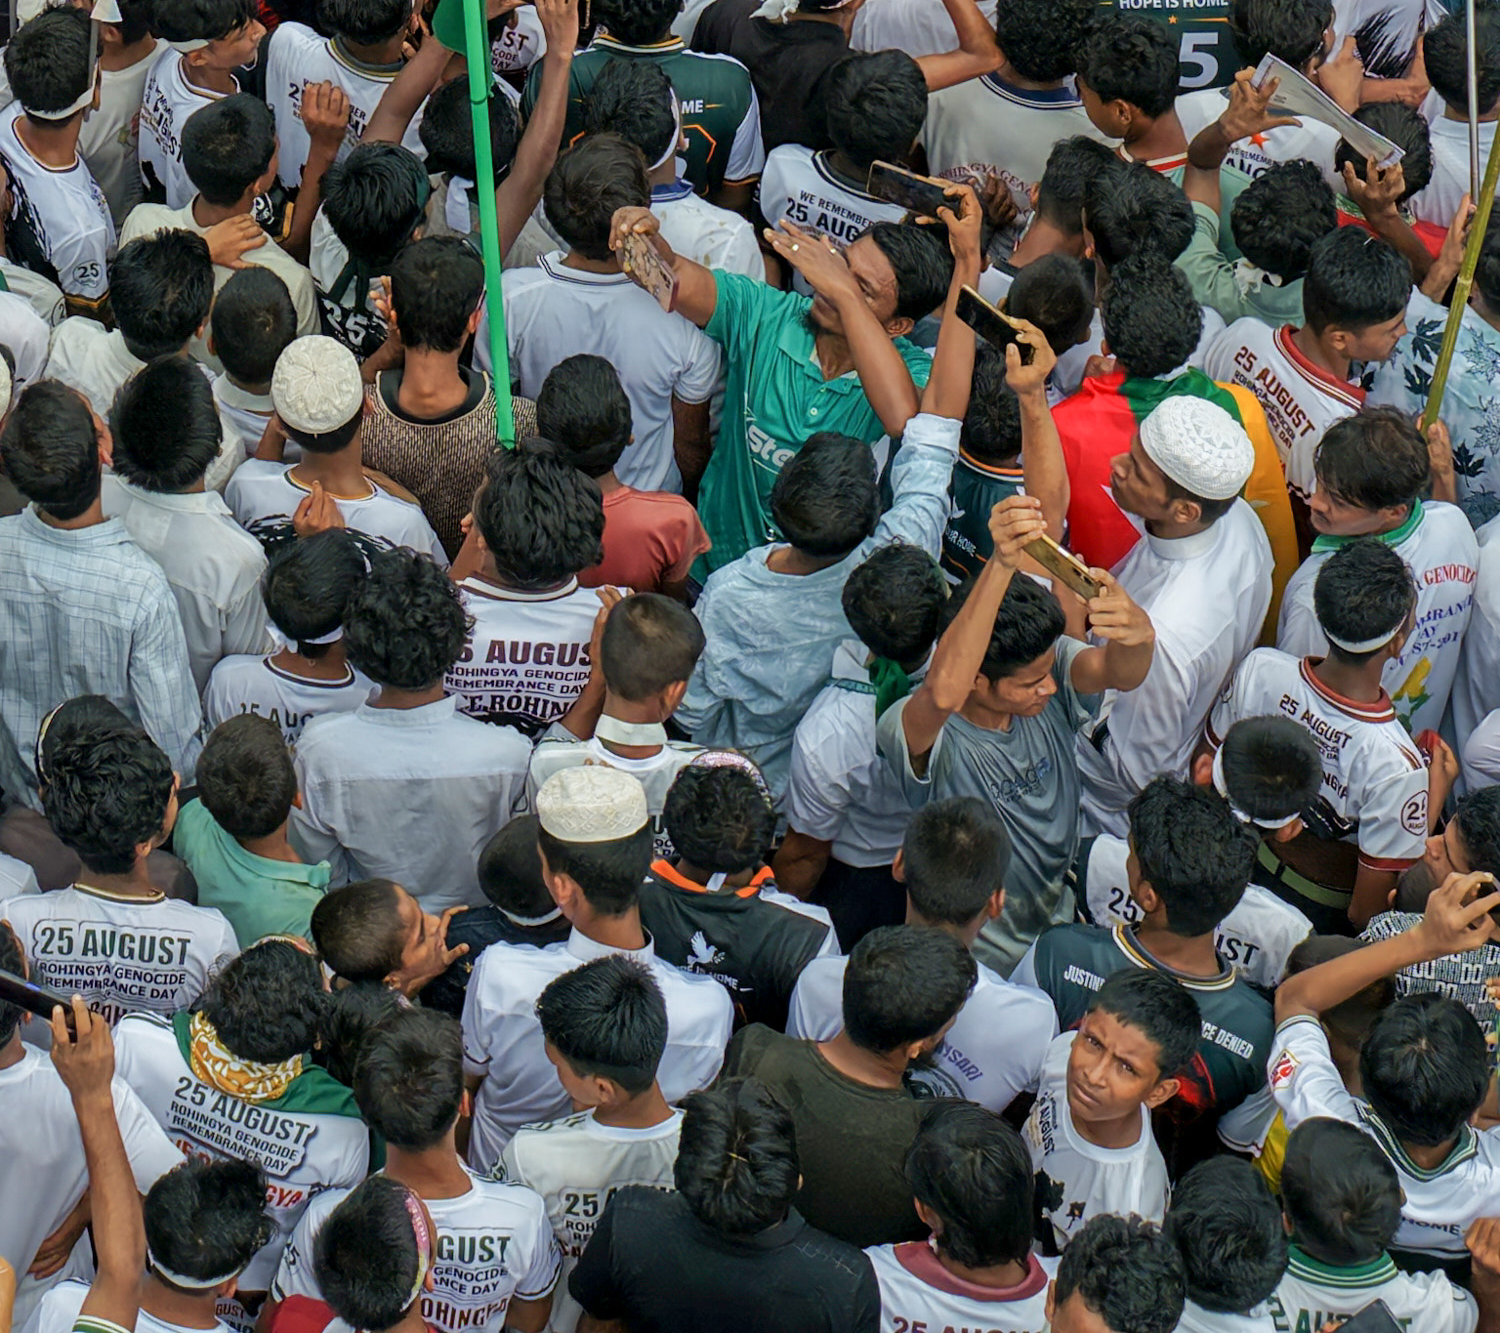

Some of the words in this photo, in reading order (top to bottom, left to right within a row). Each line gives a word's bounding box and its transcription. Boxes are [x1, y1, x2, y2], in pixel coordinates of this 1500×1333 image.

[40, 927, 74, 955] 25
[81, 929, 191, 965] AUGUST
[39, 961, 112, 977] ROHINGYA
[114, 966, 187, 985] GENOCIDE
[45, 977, 147, 998] REMEMBRANCE
[150, 988, 179, 1000] DAY
[170, 1100, 232, 1137] ROHINGYA
[234, 1128, 300, 1162] GENOCIDE
[174, 1076, 209, 1106] 25
[210, 1093, 310, 1147] AUGUST
[172, 1114, 262, 1163] REMEMBRANCE
[262, 1156, 289, 1173] DAY
